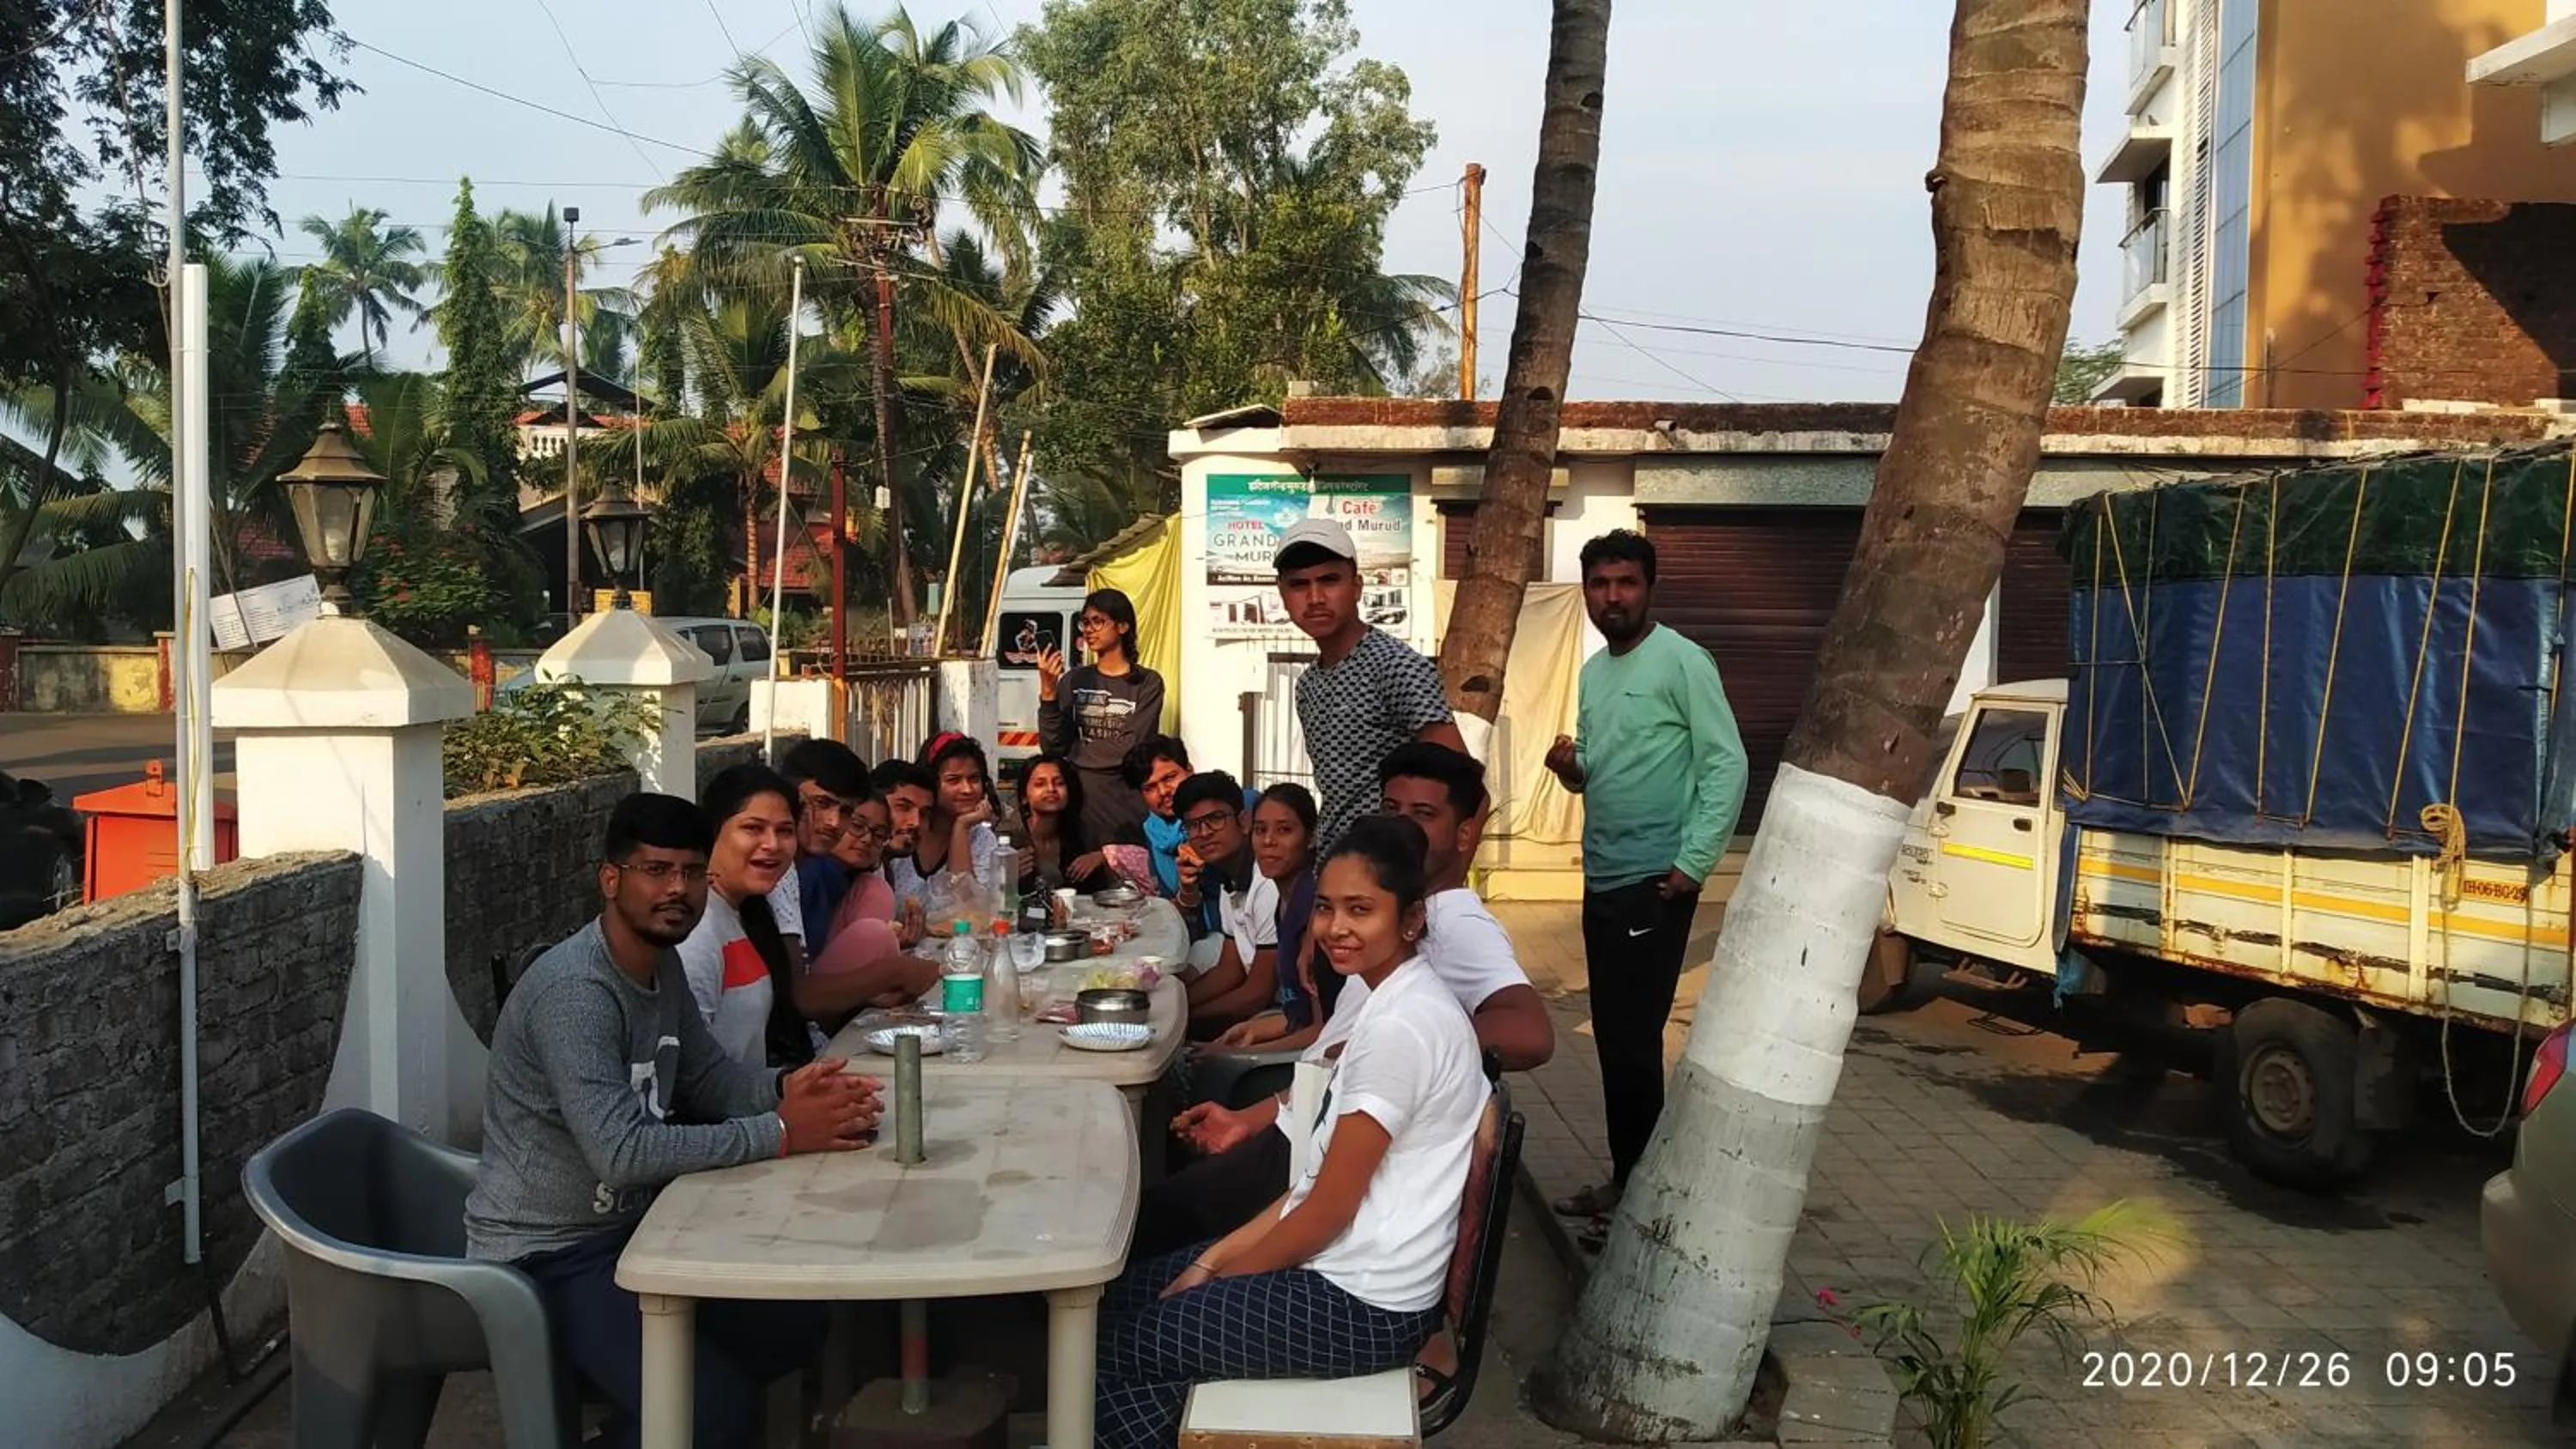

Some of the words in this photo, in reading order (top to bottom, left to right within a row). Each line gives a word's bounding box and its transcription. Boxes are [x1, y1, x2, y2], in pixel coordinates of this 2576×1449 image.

[1228, 521, 1264, 530] HOTEL
[1358, 519, 1401, 531] Murud
[1213, 534, 1277, 547] GRAND
